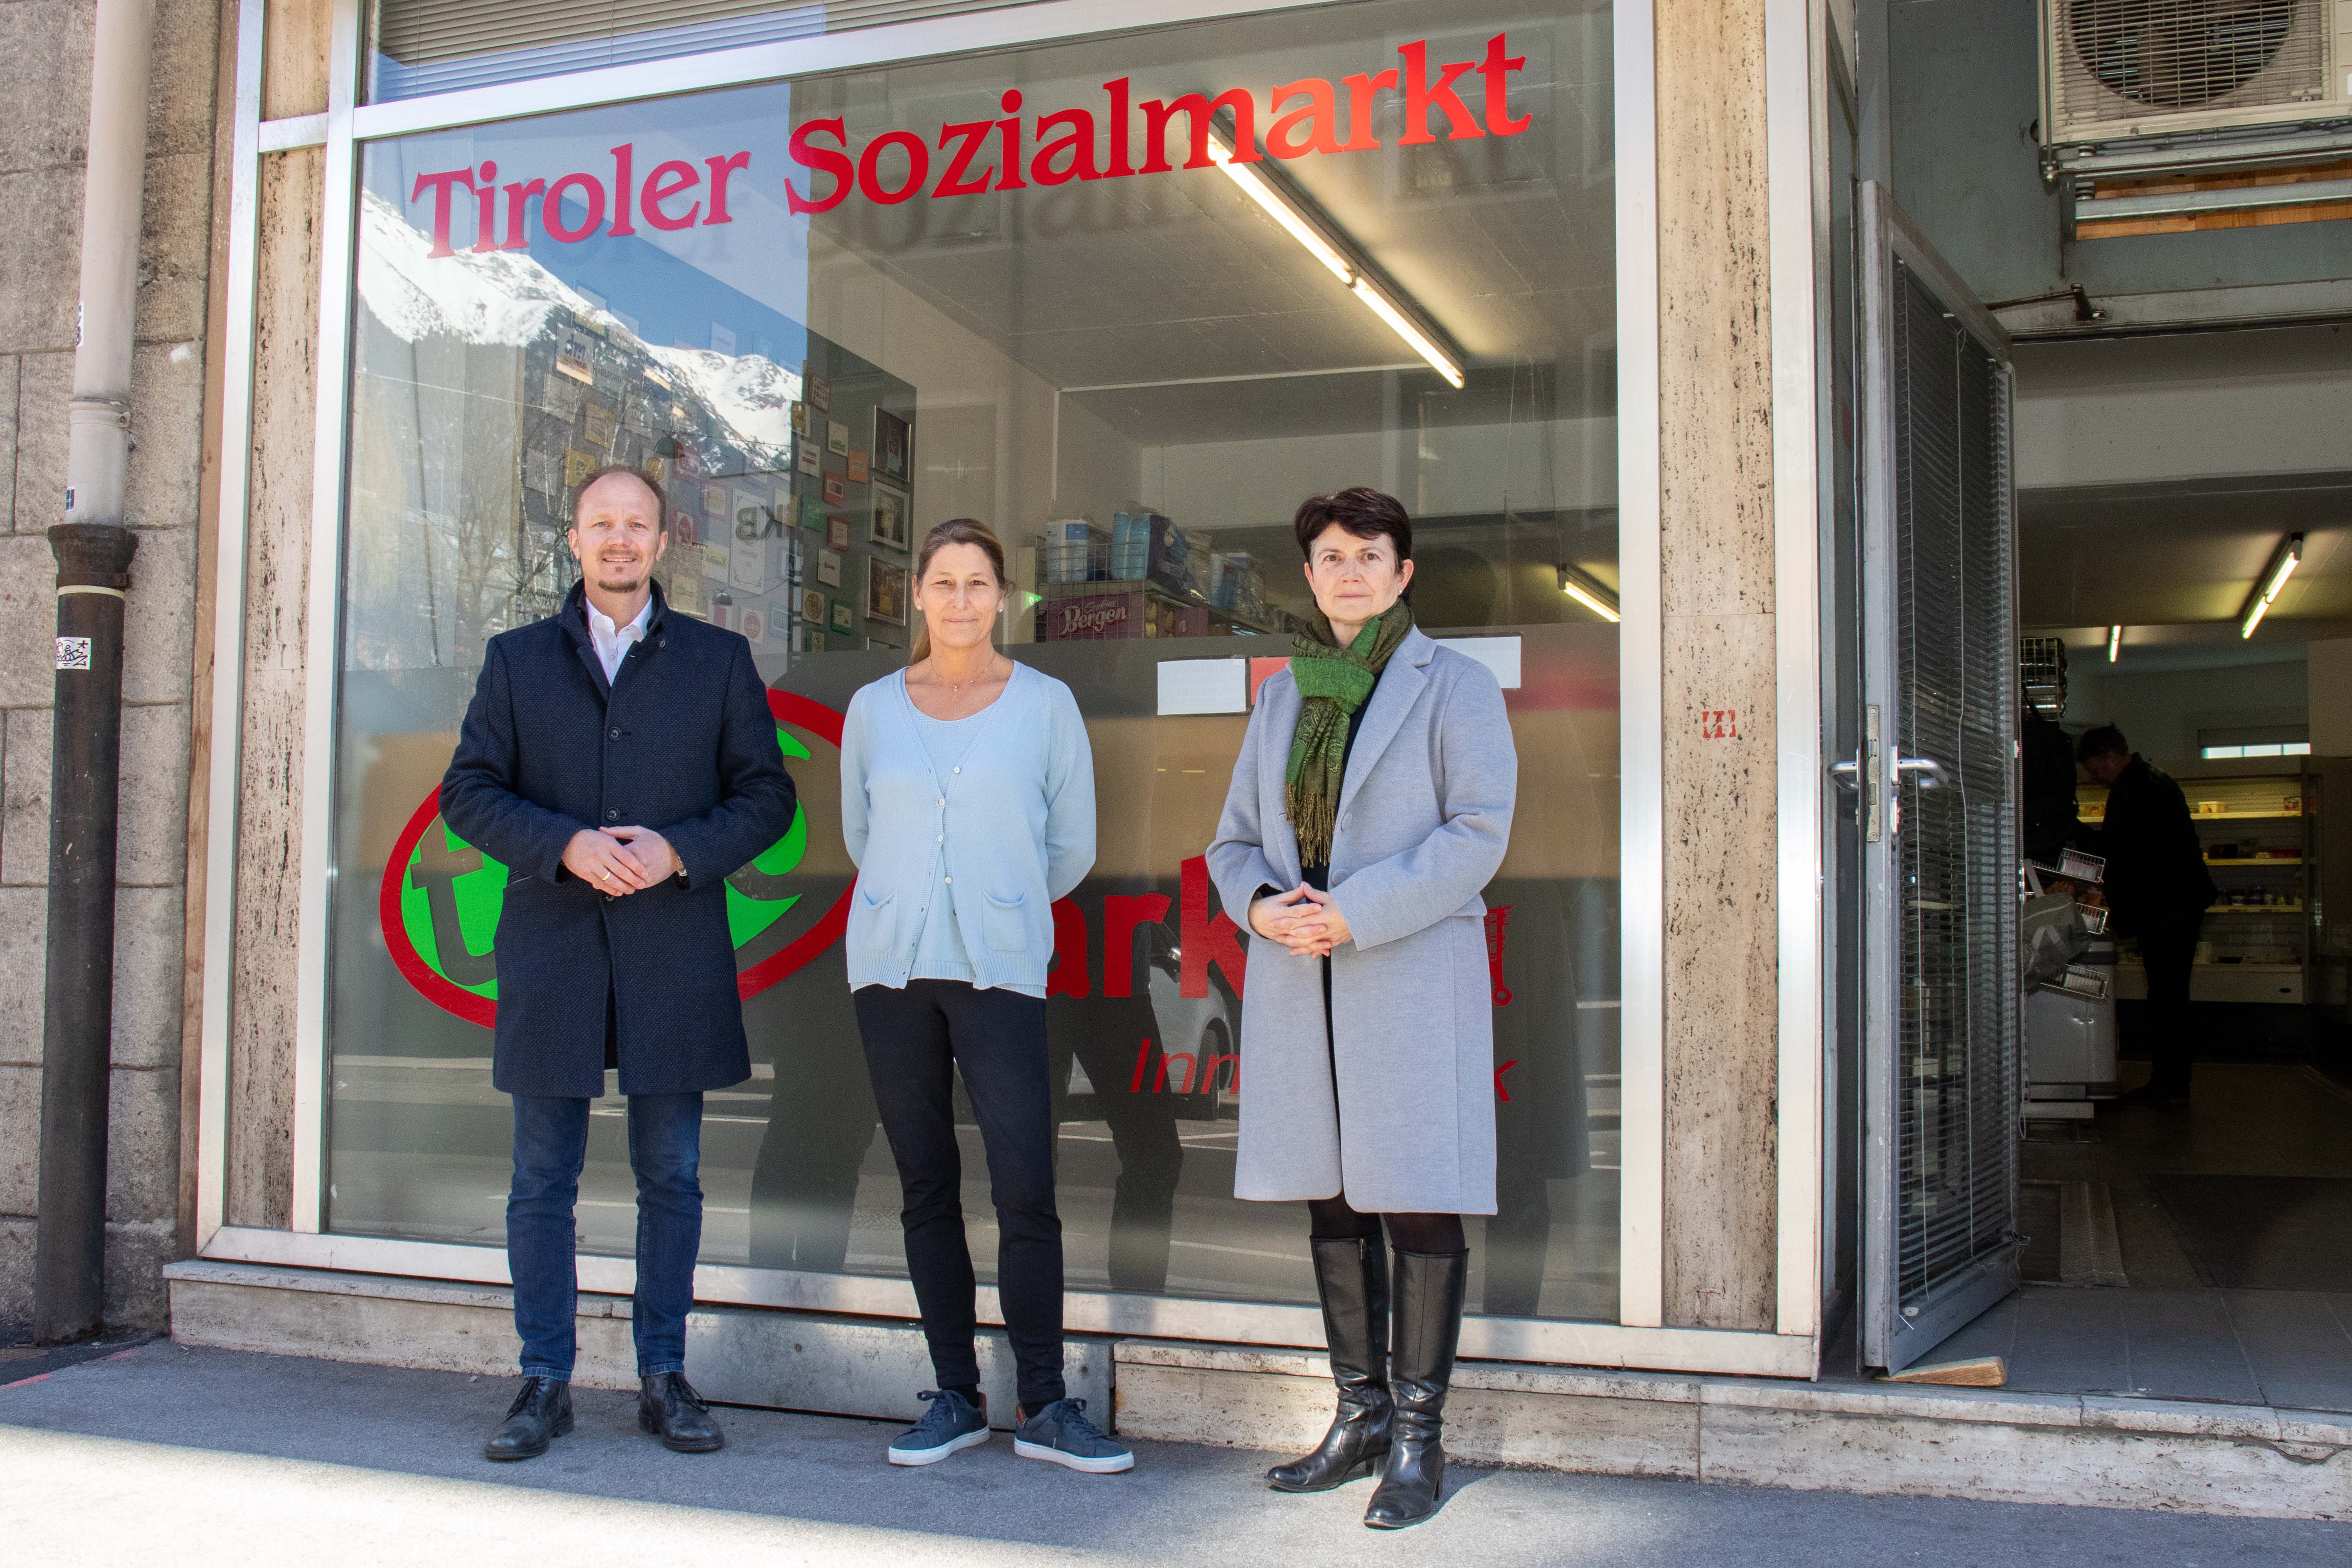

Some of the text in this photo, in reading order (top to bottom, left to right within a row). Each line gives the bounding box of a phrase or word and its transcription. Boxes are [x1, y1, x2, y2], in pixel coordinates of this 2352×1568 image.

[411, 32, 1533, 259] Tiroler Sozialmarkt
[1059, 605, 1127, 635] Bergen
